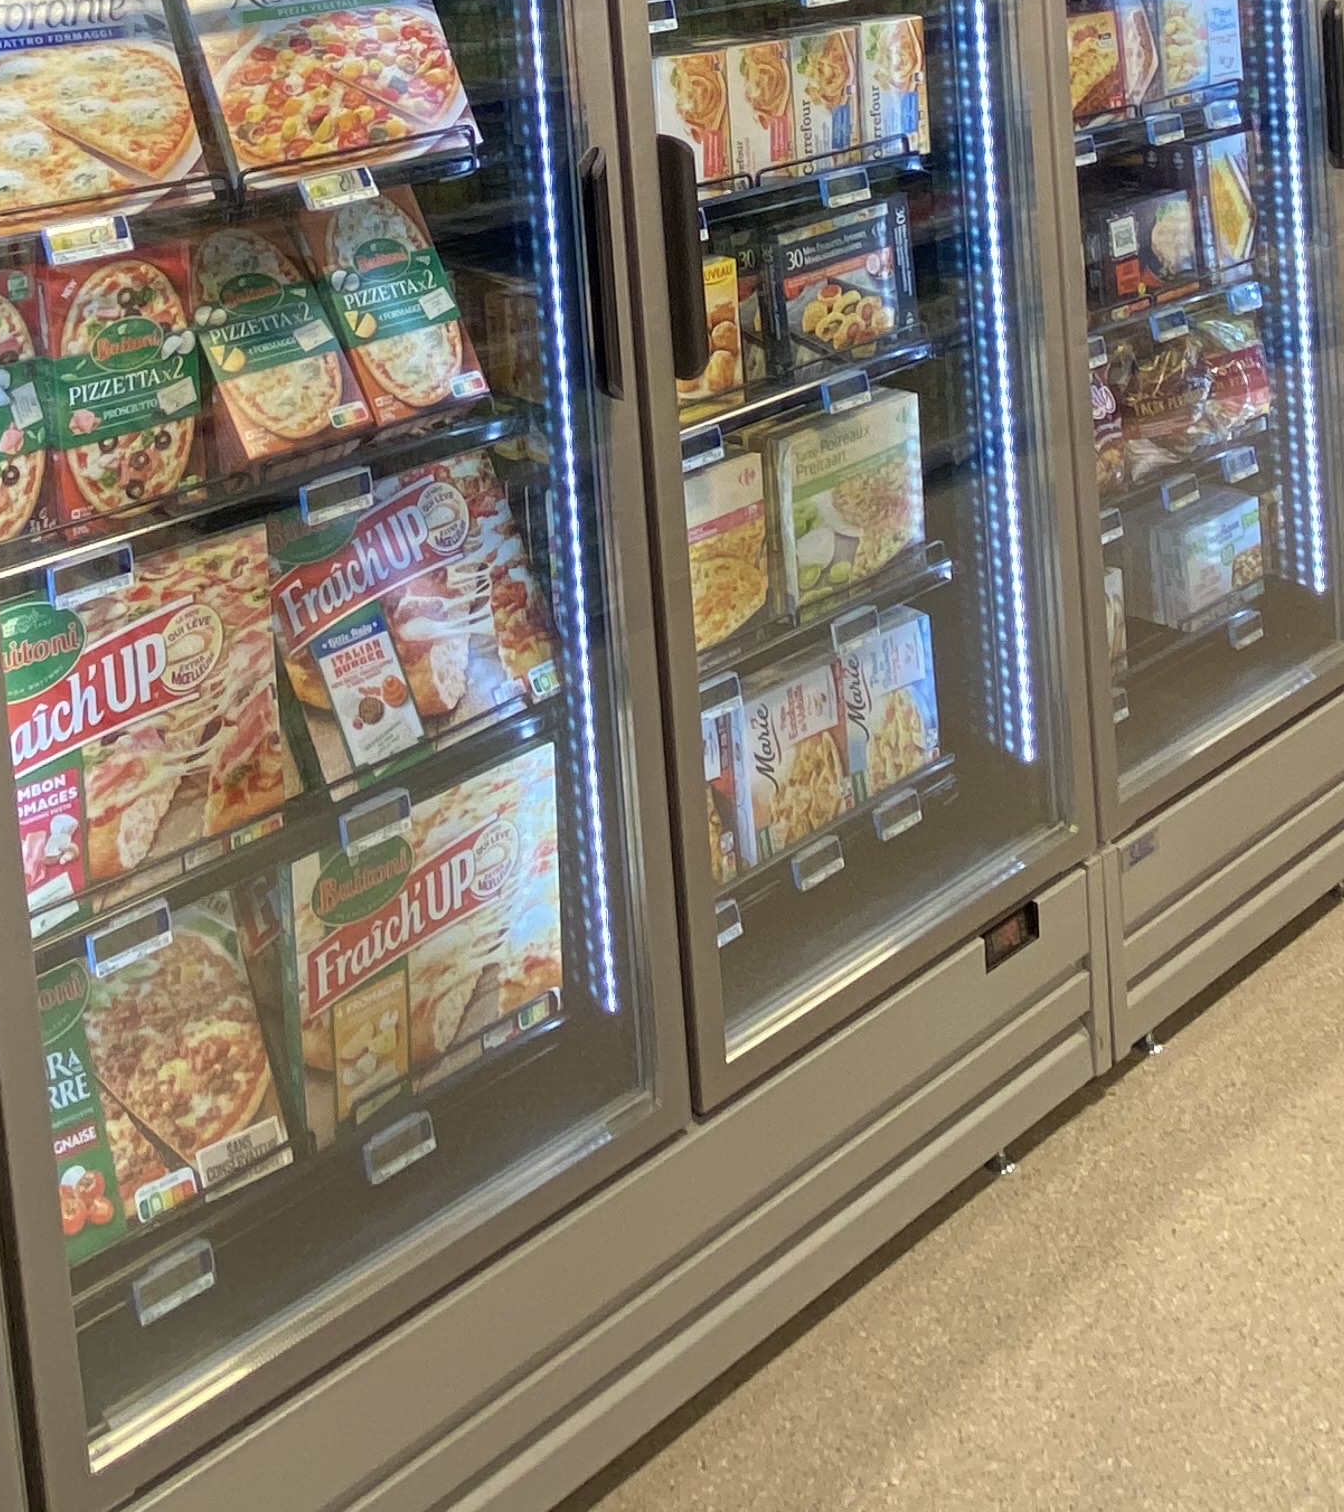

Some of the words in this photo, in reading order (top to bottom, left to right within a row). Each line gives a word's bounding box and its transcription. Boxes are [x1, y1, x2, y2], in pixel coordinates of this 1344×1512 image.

[276, 4, 308, 18] PIZZA
[47, 28, 114, 45] FORMAGGI
[895, 206, 907, 226] 30
[738, 248, 756, 270] 30
[785, 248, 804, 271] 30
[343, 278, 420, 311] PIZZETTA
[209, 311, 294, 347] PIZZETTA
[68, 368, 161, 407] PIZZETTA
[102, 397, 159, 421] PROSCIUTTO
[819, 424, 871, 453] Poireaux
[278, 503, 430, 639] Fraîch'UP
[167, 627, 185, 643] QUI
[186, 615, 212, 631] LÈVE
[330, 638, 383, 668] ITALIAN
[333, 650, 386, 679] BURGER
[843, 652, 871, 744] Marie
[754, 702, 782, 795] Marie
[16, 773, 67, 803] MBON
[315, 848, 476, 1002] Fraîch'UP
